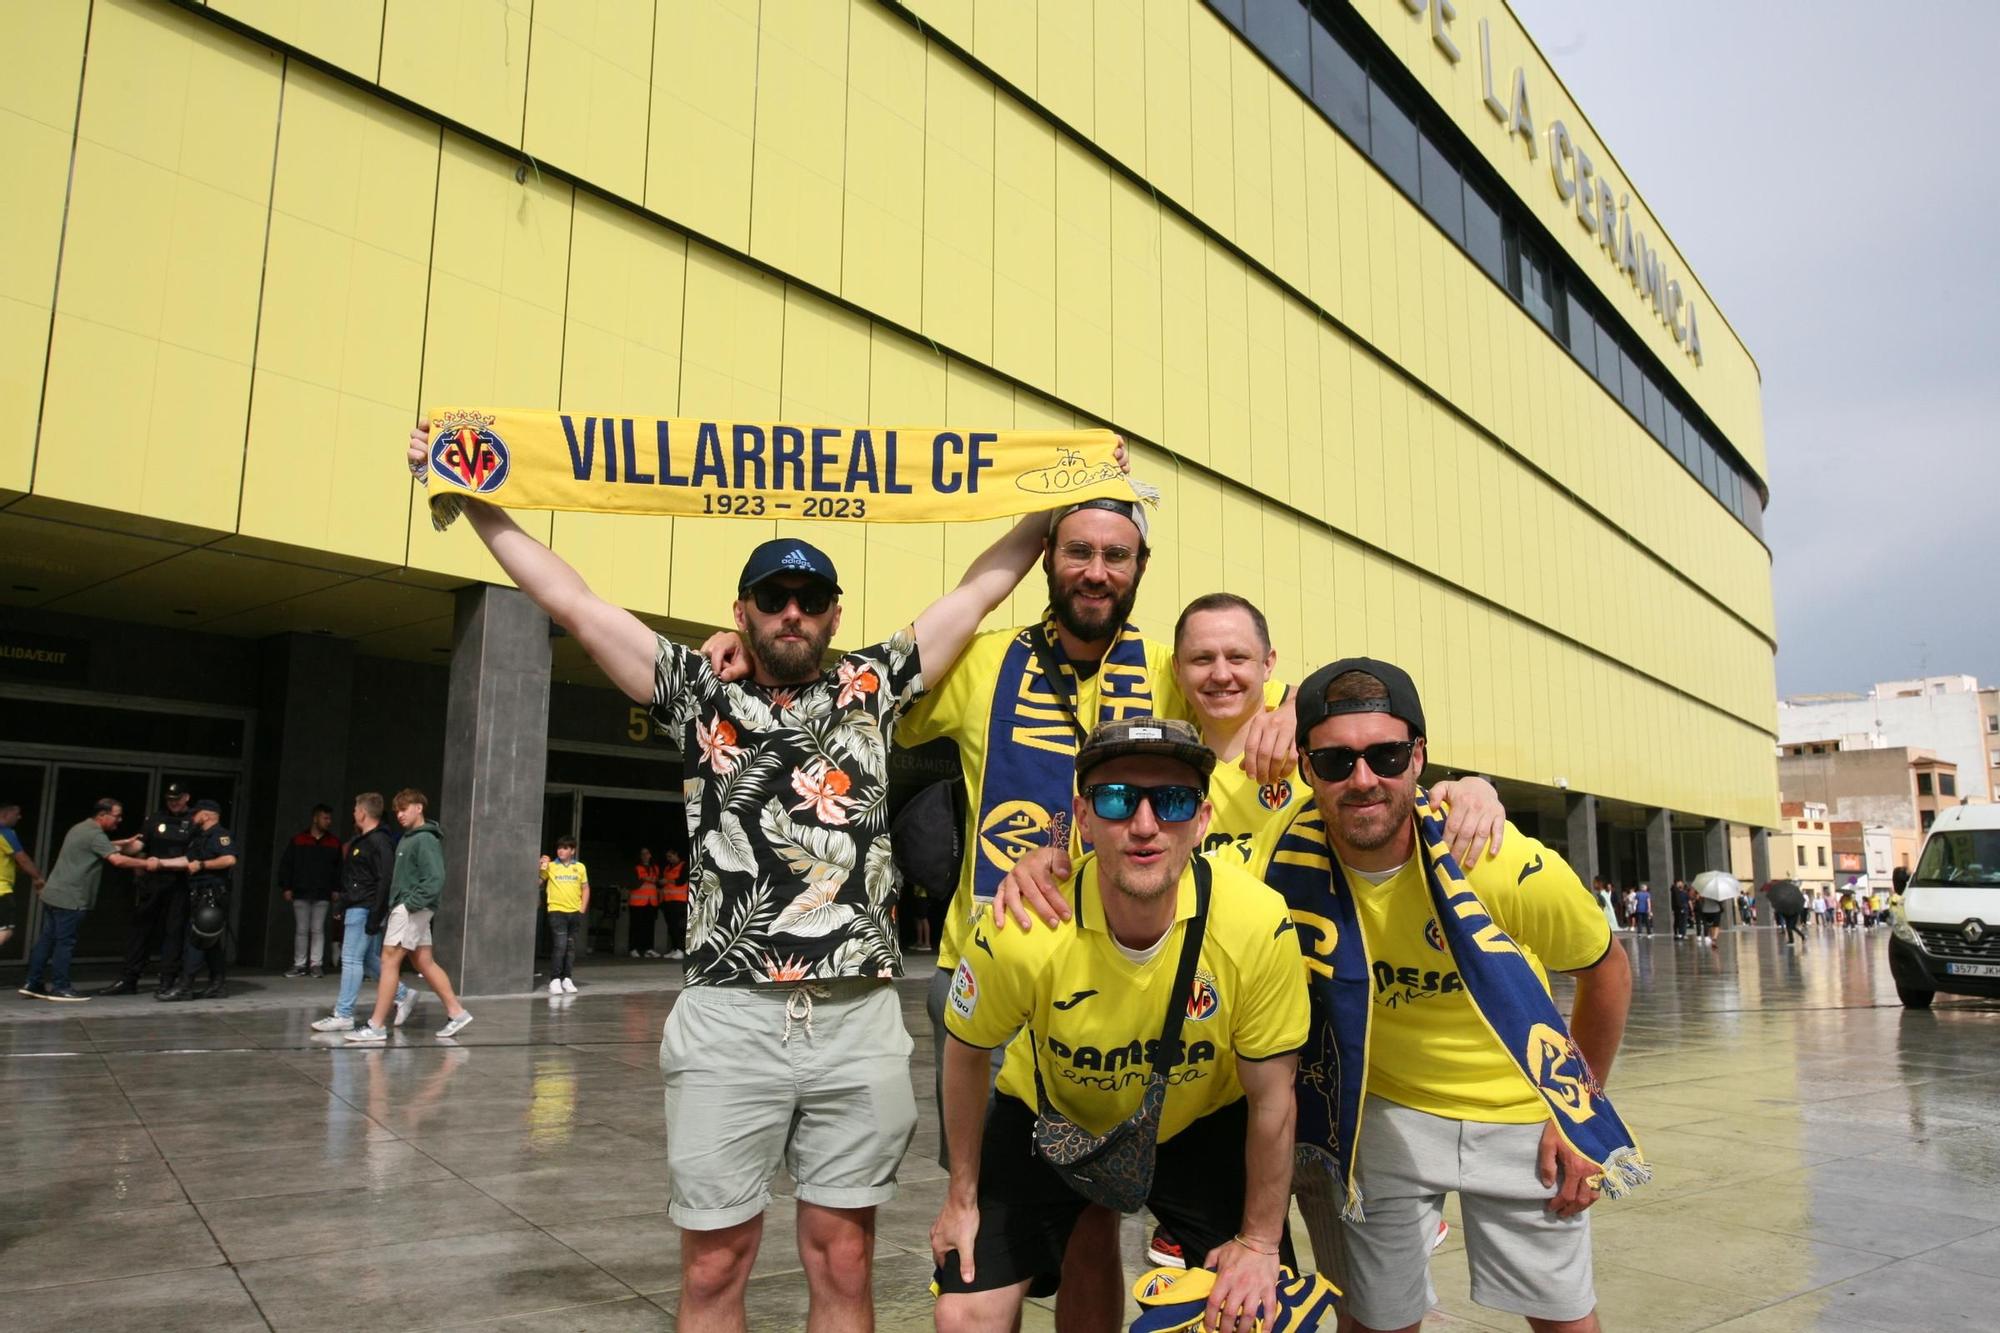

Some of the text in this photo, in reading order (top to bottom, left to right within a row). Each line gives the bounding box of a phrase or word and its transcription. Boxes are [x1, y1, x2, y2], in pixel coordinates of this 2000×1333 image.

[1479, 17, 1538, 160] LA
[560, 415, 998, 494] VILLARREAL CF
[703, 494, 766, 516] 1923
[803, 497, 866, 518] 2023
[780, 557, 812, 568] adidas
[627, 706, 649, 742] 5
